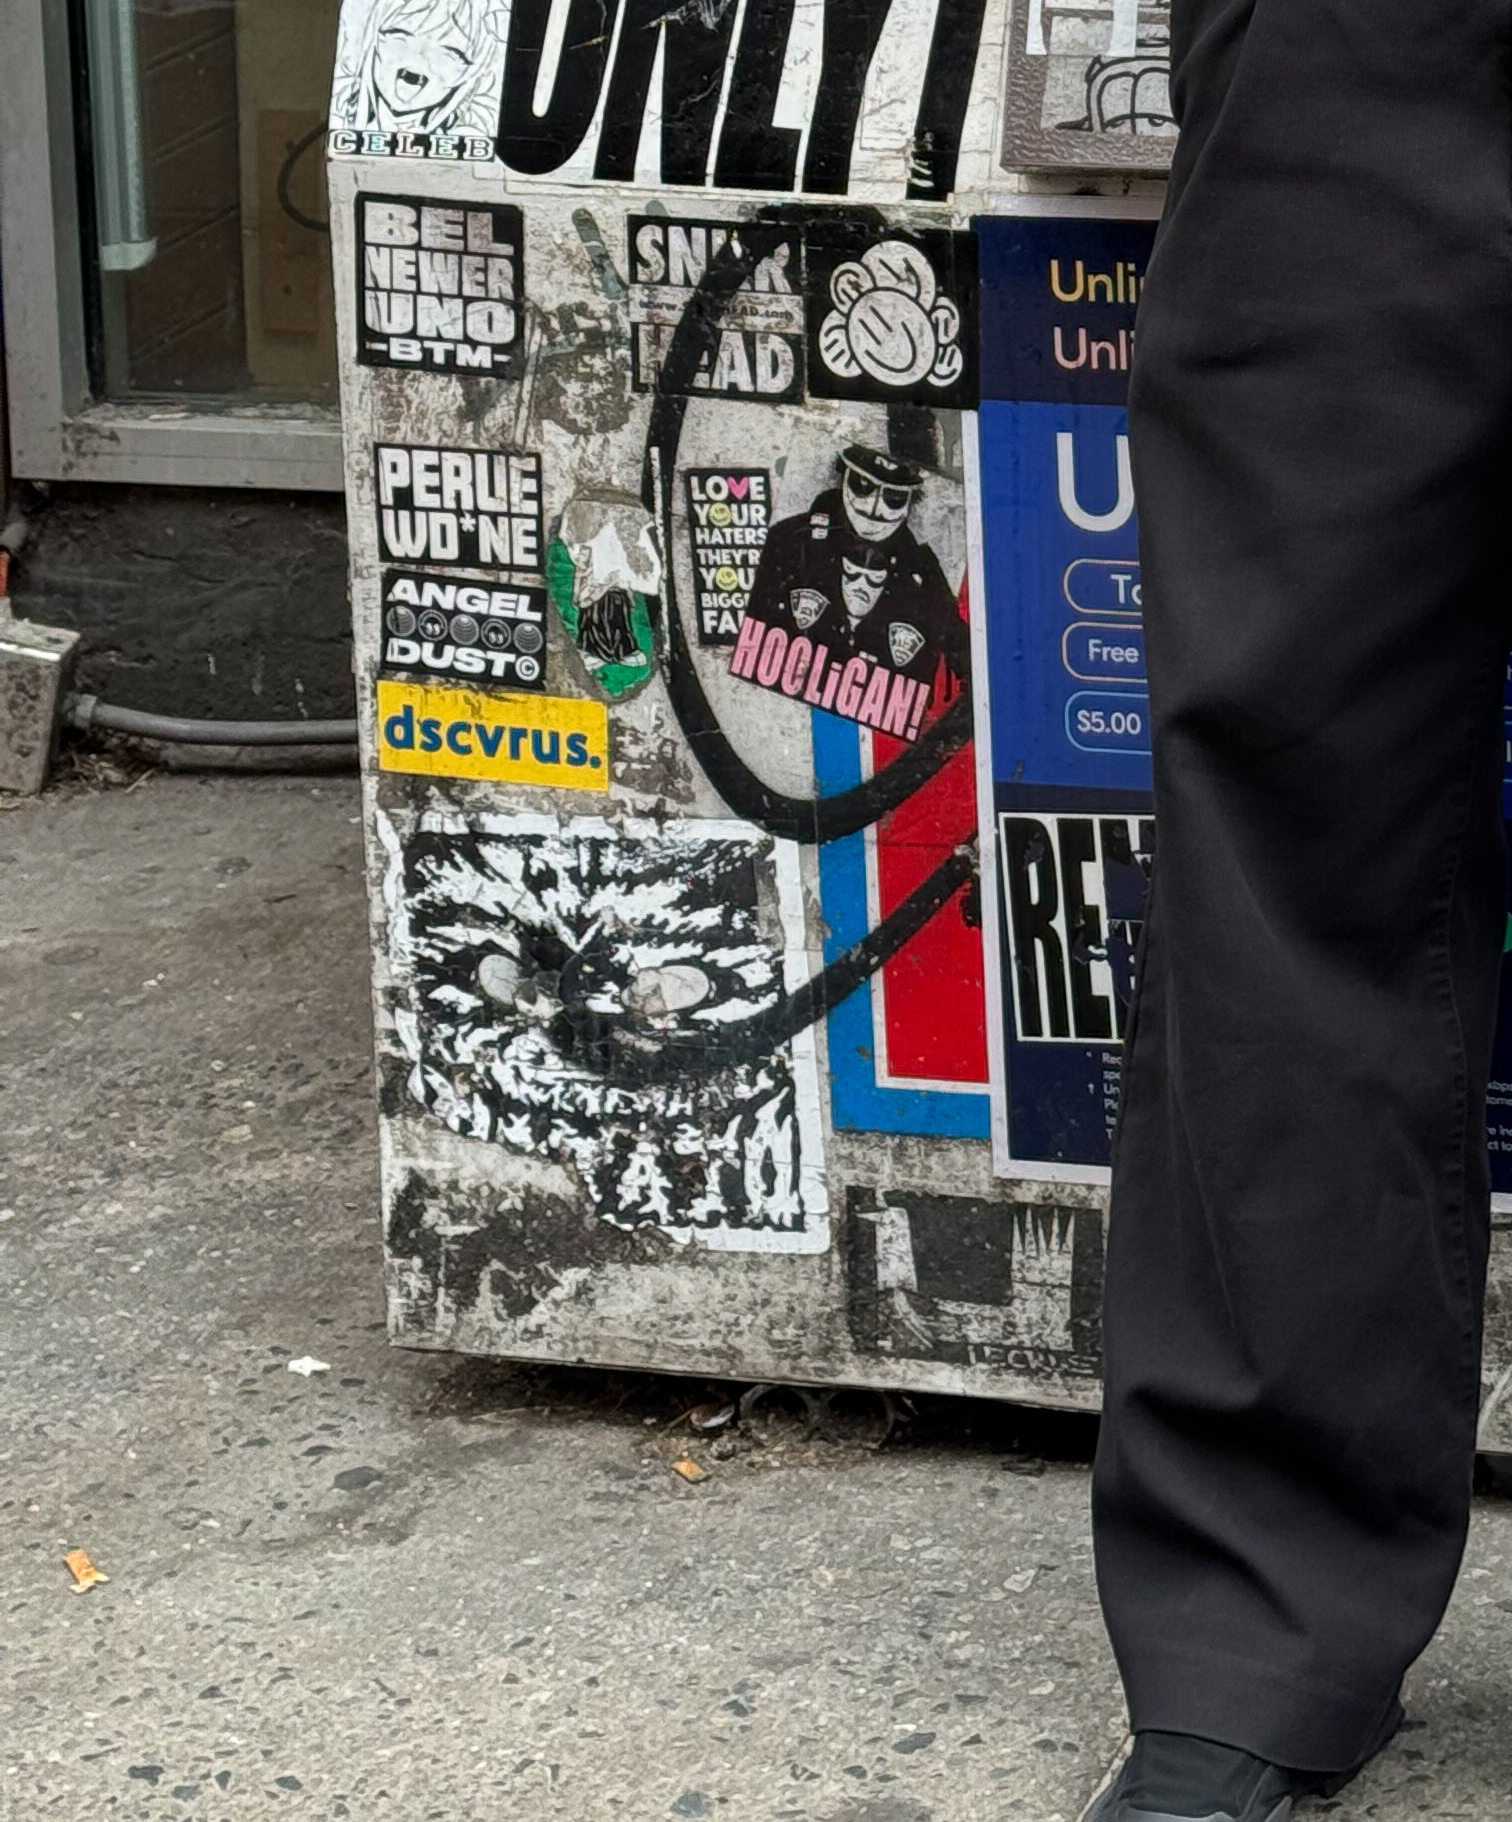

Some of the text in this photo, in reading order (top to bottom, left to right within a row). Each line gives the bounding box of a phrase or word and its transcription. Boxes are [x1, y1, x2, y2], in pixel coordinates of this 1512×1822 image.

[331, 129, 496, 161] CELEB
[363, 200, 514, 256] BEL
[364, 246, 514, 301] NEWER
[1050, 258, 1145, 304] Unli
[364, 292, 515, 346] UNO
[695, 528, 769, 546] HATERS
[696, 548, 761, 566] THEY'R
[385, 578, 543, 623] ANGEL
[700, 592, 750, 608] BIGG
[1088, 638, 1139, 665] Free
[384, 705, 603, 770] dscvrus.
[1076, 709, 1142, 736] $5.00
[1005, 815, 1152, 1040] RE
